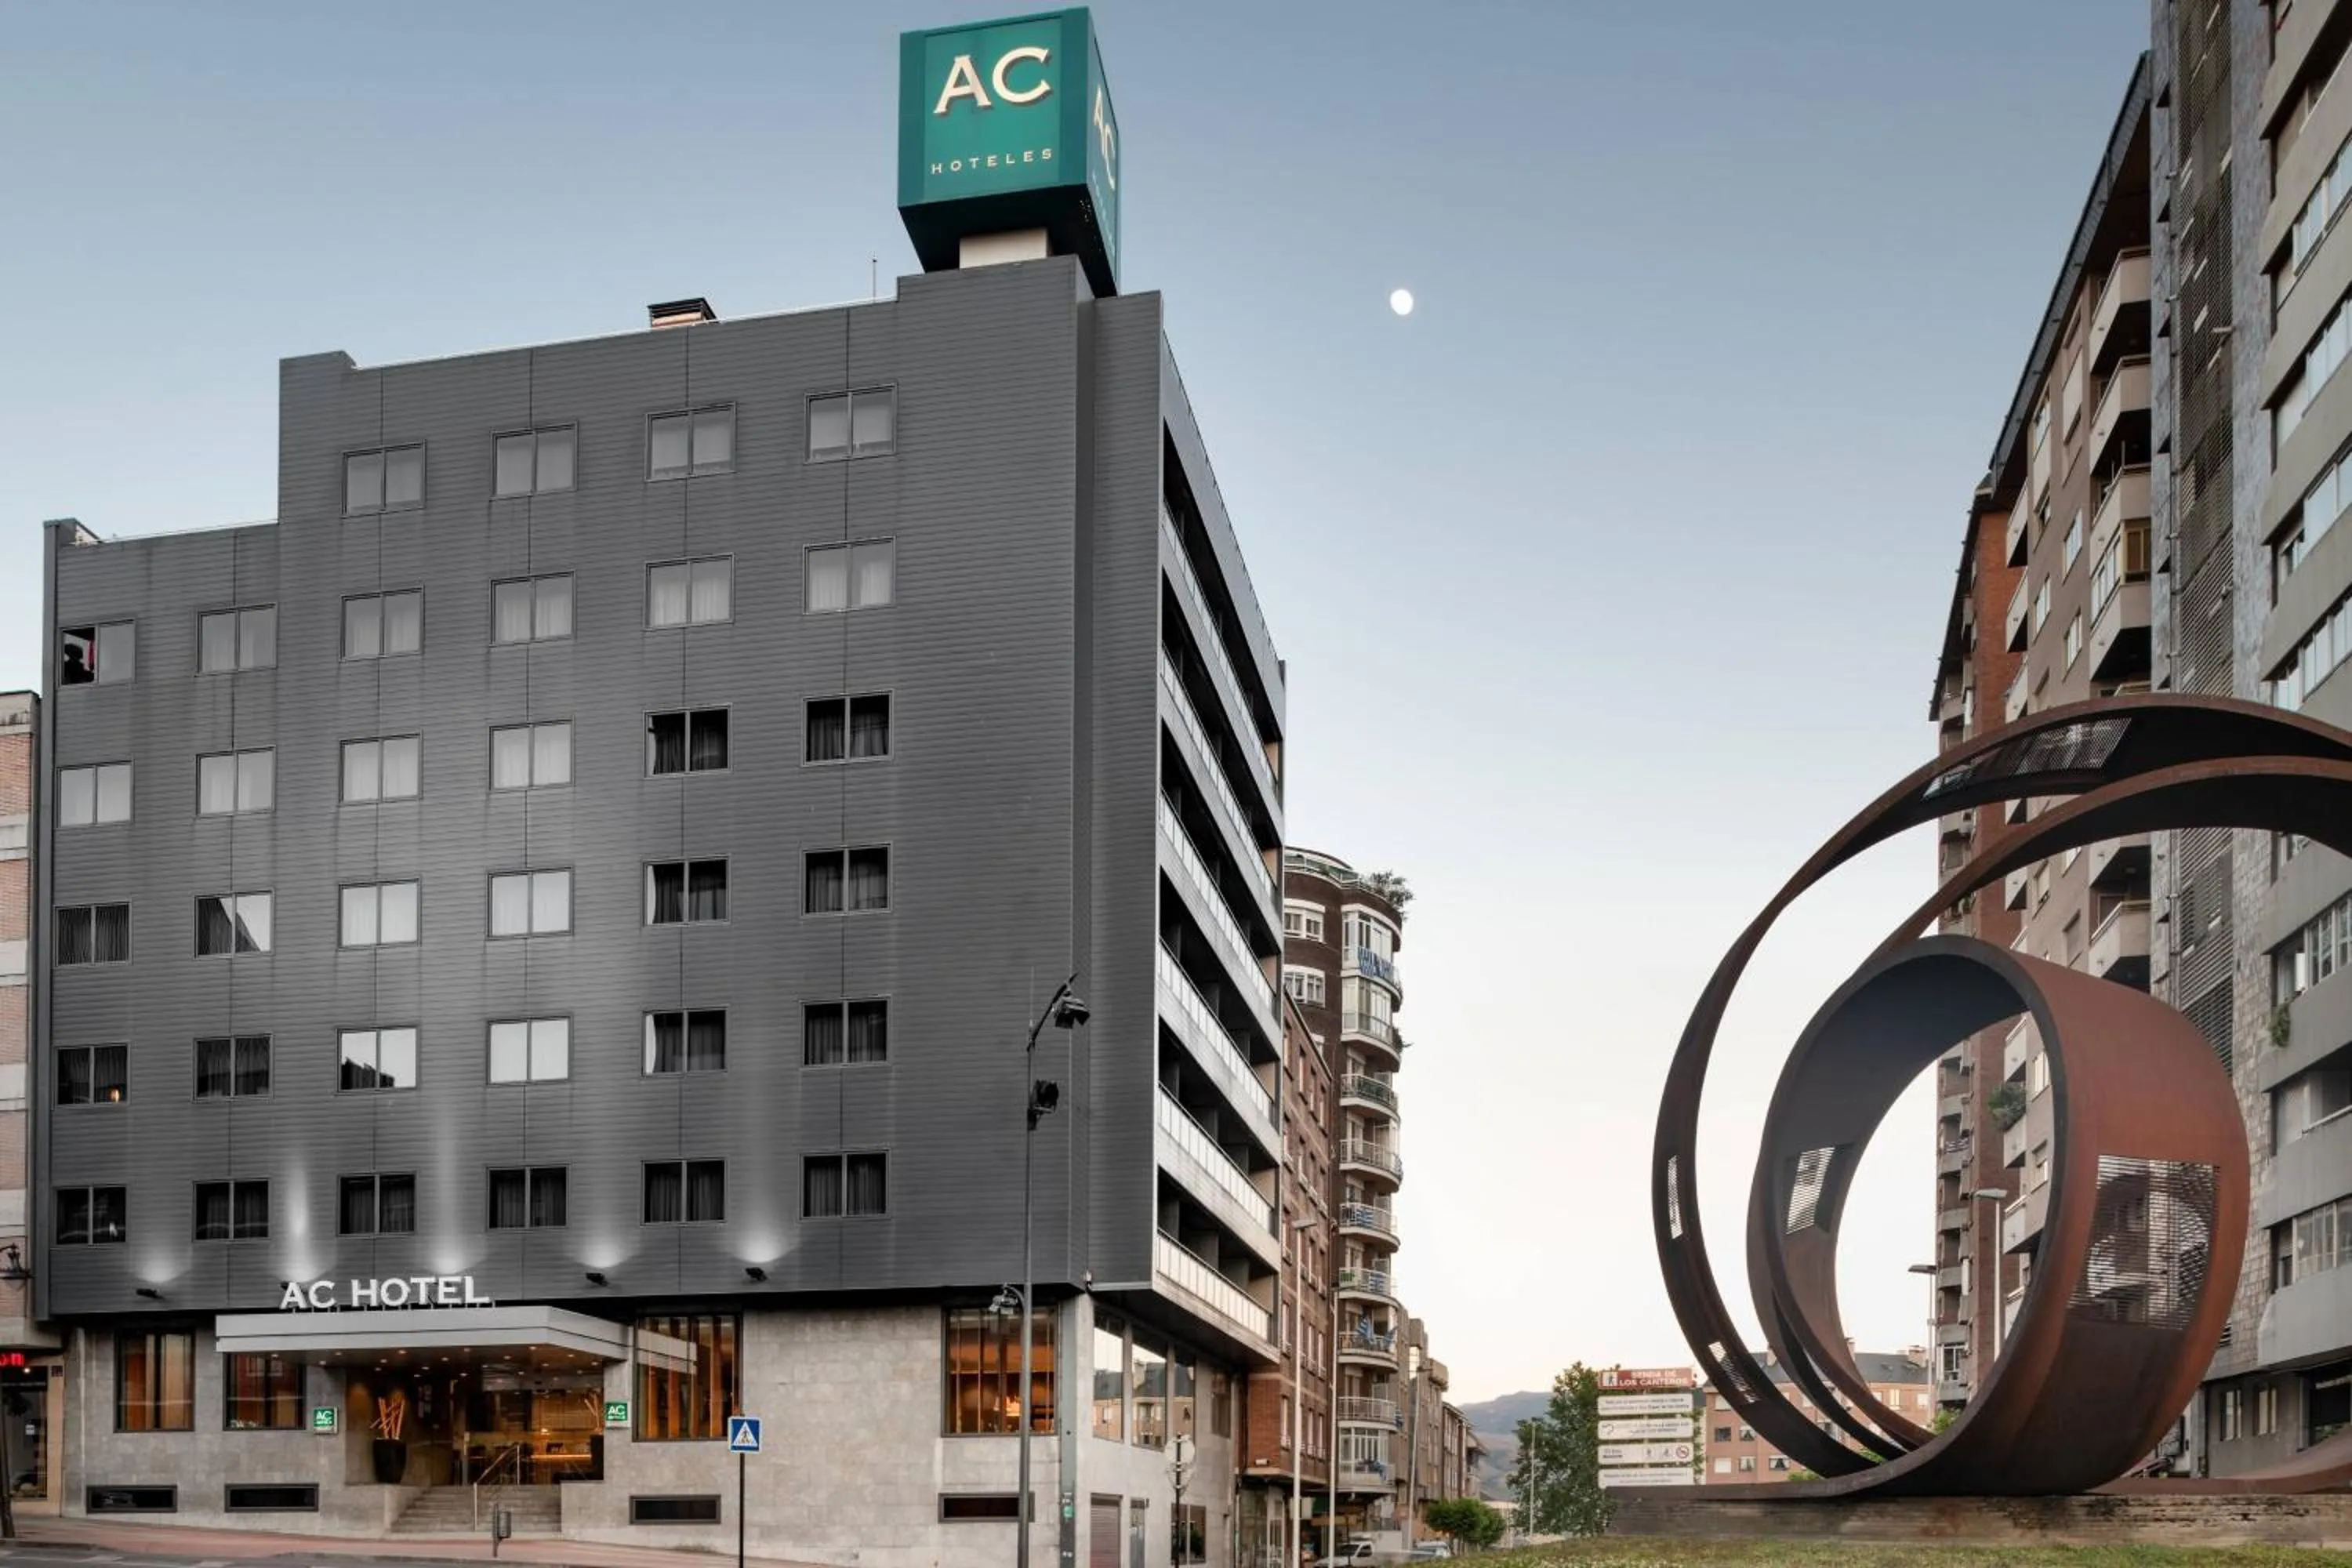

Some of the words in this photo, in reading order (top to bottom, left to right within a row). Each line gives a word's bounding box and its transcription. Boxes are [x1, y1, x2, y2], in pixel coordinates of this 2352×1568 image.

[933, 46, 1051, 114] AC
[1094, 87, 1116, 191] AC
[931, 148, 1053, 175] HOTELES
[280, 1280, 336, 1309] AC
[351, 1276, 490, 1307] HOTEL
[316, 1411, 332, 1420] AC
[608, 1405, 626, 1415] AC
